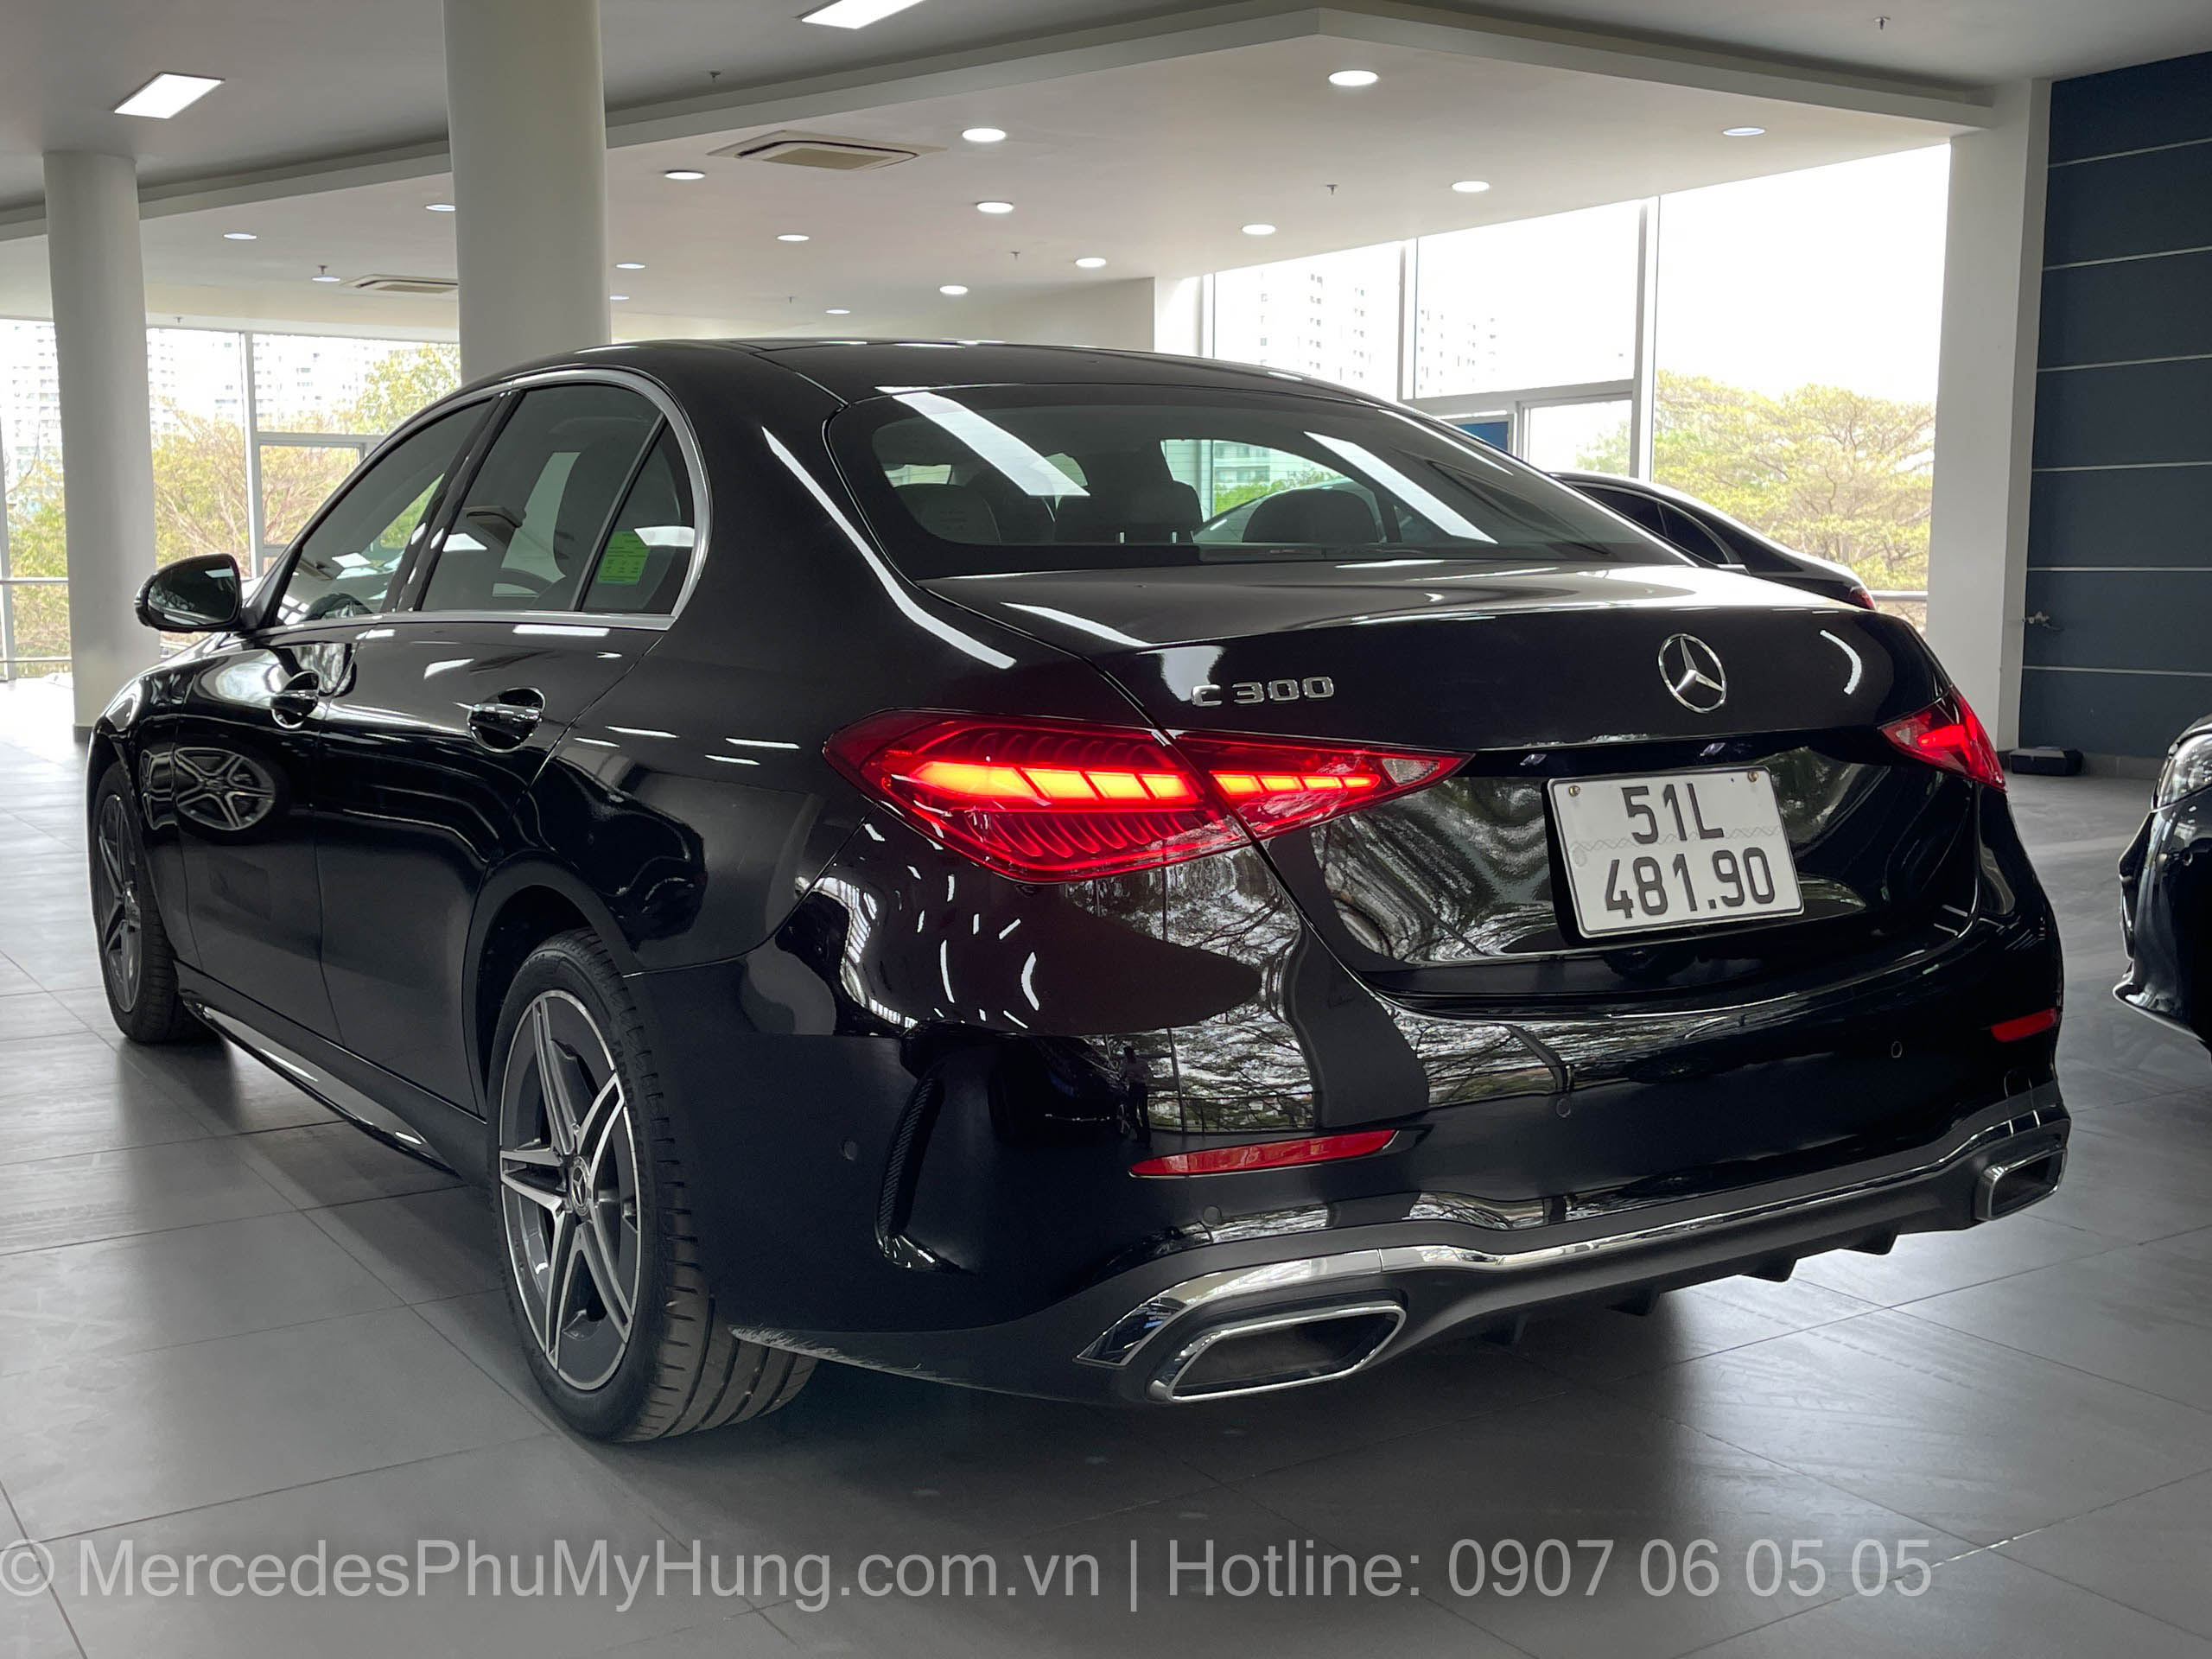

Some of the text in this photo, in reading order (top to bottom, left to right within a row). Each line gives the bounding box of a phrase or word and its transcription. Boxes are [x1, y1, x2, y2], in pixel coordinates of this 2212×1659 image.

[1192, 677, 1334, 707] C 300
[1621, 782, 1724, 845] 51L
[1605, 847, 1776, 918] 481.90
